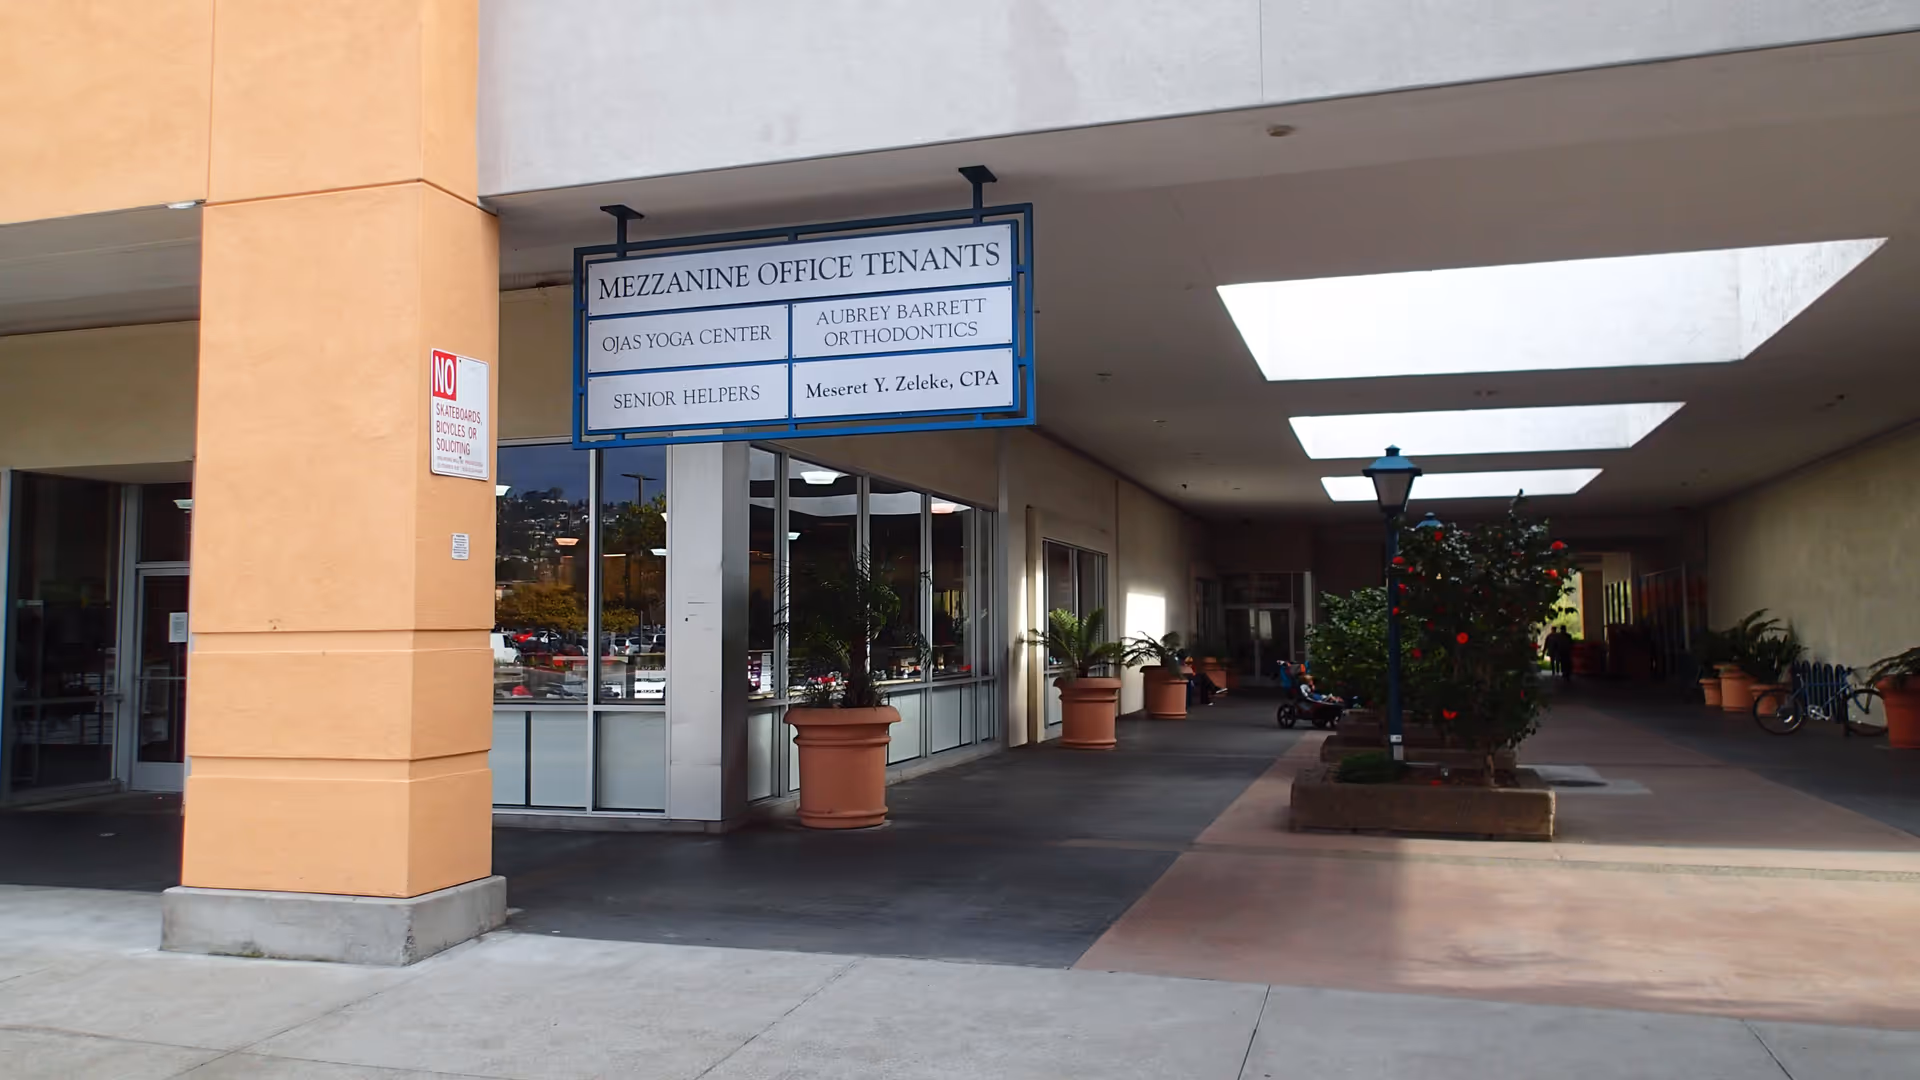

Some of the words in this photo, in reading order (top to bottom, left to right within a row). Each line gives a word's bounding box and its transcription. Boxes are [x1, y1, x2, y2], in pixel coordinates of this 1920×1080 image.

[598, 265, 751, 300] MEZZANINE
[757, 255, 854, 286] OFFICE
[860, 242, 1001, 276] TENANTS
[816, 305, 892, 326] AUBREY
[897, 298, 987, 319] BARRETT
[602, 334, 642, 354] OJAS
[645, 331, 694, 349] YOGA
[699, 324, 772, 345] CENTER
[824, 321, 978, 348] ORTHODONTICS
[434, 355, 456, 396] NO
[805, 382, 868, 399] Meseret
[873, 377, 889, 393] Y.
[895, 373, 954, 392] Zeleke,
[959, 369, 1000, 387] CPA
[613, 390, 677, 410] SENIOR
[683, 384, 760, 405] HELPERS
[436, 420, 466, 438] BICYCLES
[468, 428, 477, 440] OR
[436, 438, 470, 456] SOLICITING
